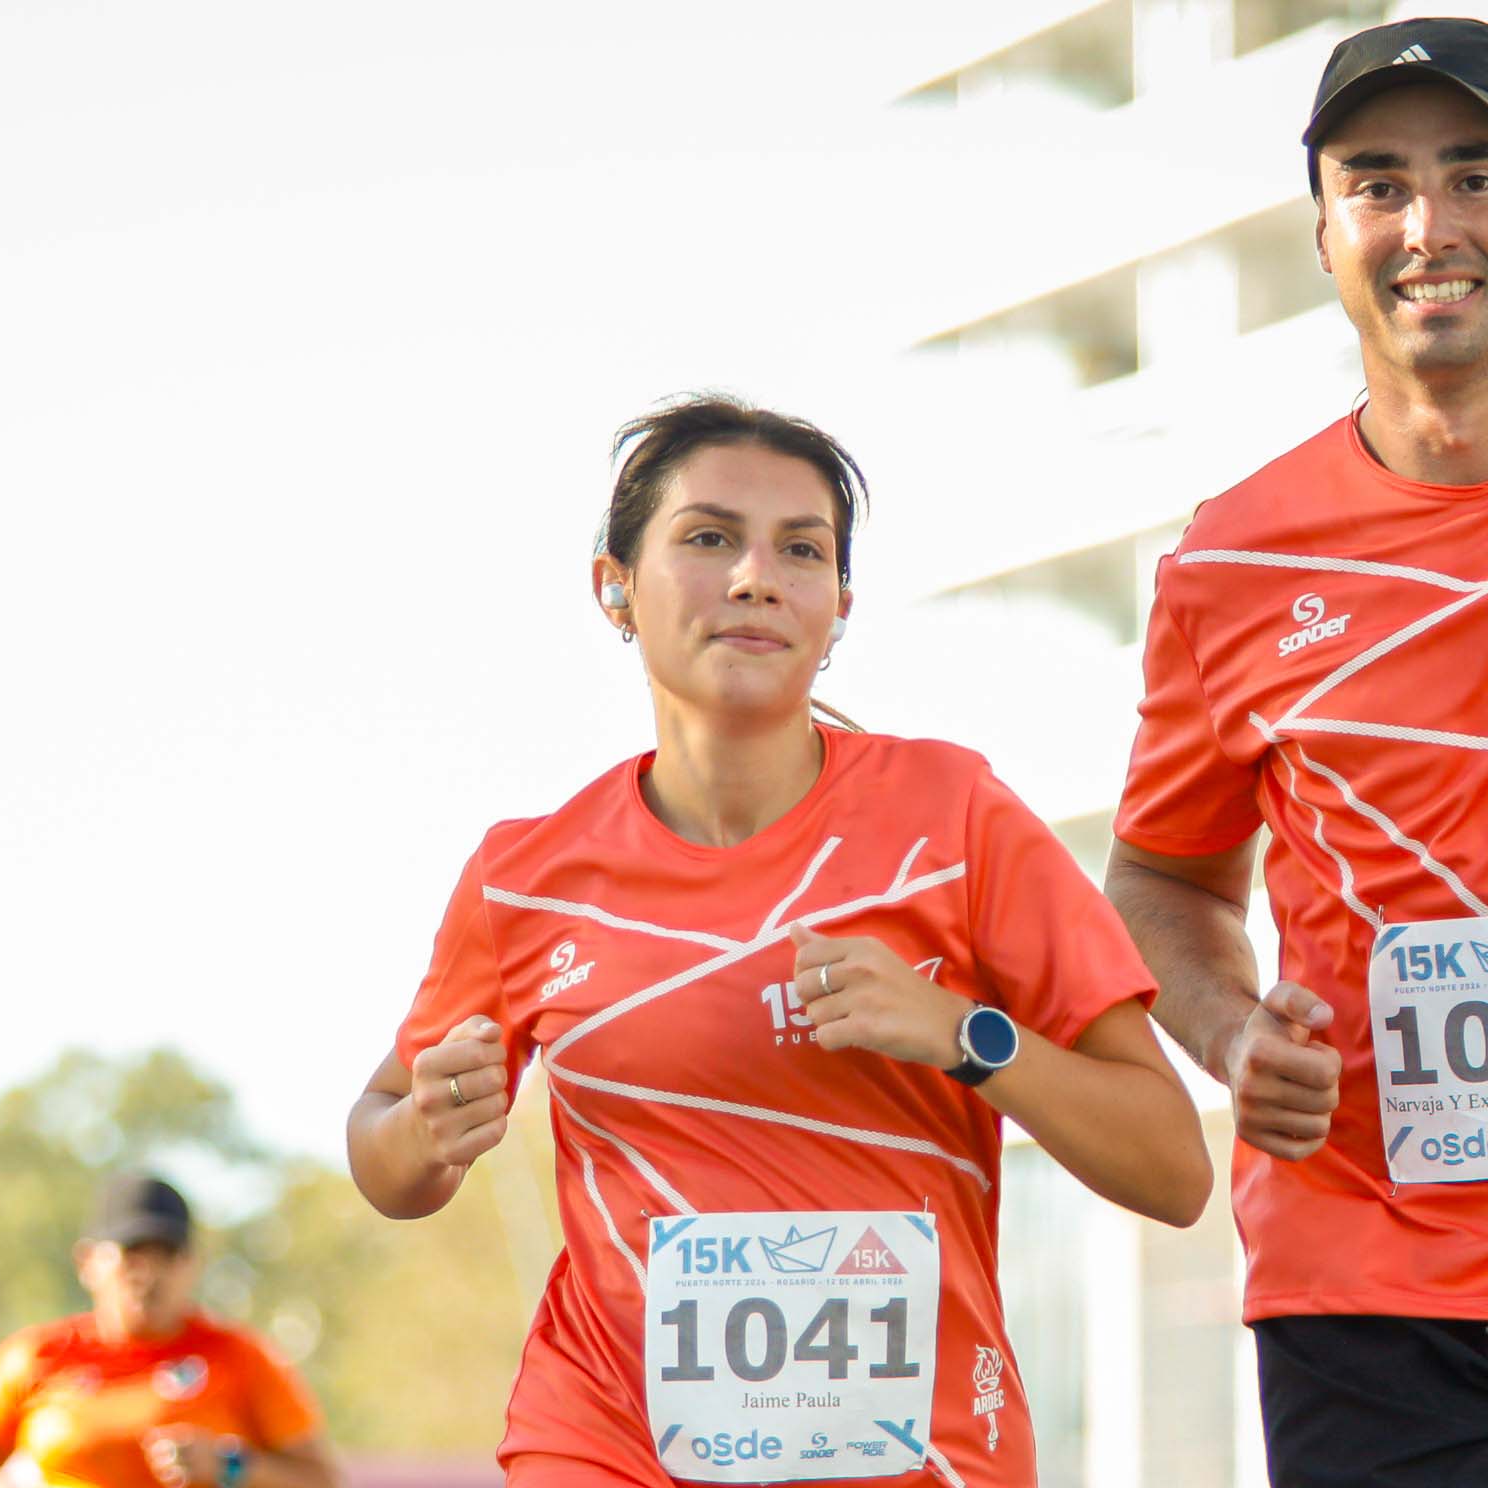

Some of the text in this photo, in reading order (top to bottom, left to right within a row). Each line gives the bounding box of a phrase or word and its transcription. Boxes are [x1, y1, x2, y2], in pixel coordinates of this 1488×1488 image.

[1390, 942, 1467, 982] 15K
[1394, 986, 1426, 995] PUERTO
[1428, 984, 1456, 993] NORTE
[761, 980, 815, 1030] 15
[775, 1030, 817, 1047] PUE
[1386, 1095, 1444, 1116] Narvaja
[1449, 1094, 1463, 1109] Y
[676, 1235, 753, 1274] 15K
[851, 1248, 891, 1269] 15K
[675, 1279, 711, 1288] PUERTO
[712, 1279, 743, 1287] NORTE
[776, 1279, 816, 1287] ROSARIO
[838, 1278, 851, 1286] DE
[853, 1278, 878, 1286] ABRIL
[661, 1297, 921, 1382] 1041
[741, 1392, 841, 1409] Jaime Paula
[973, 1388, 1005, 1416] ARDEC
[846, 1441, 888, 1450] POWER
